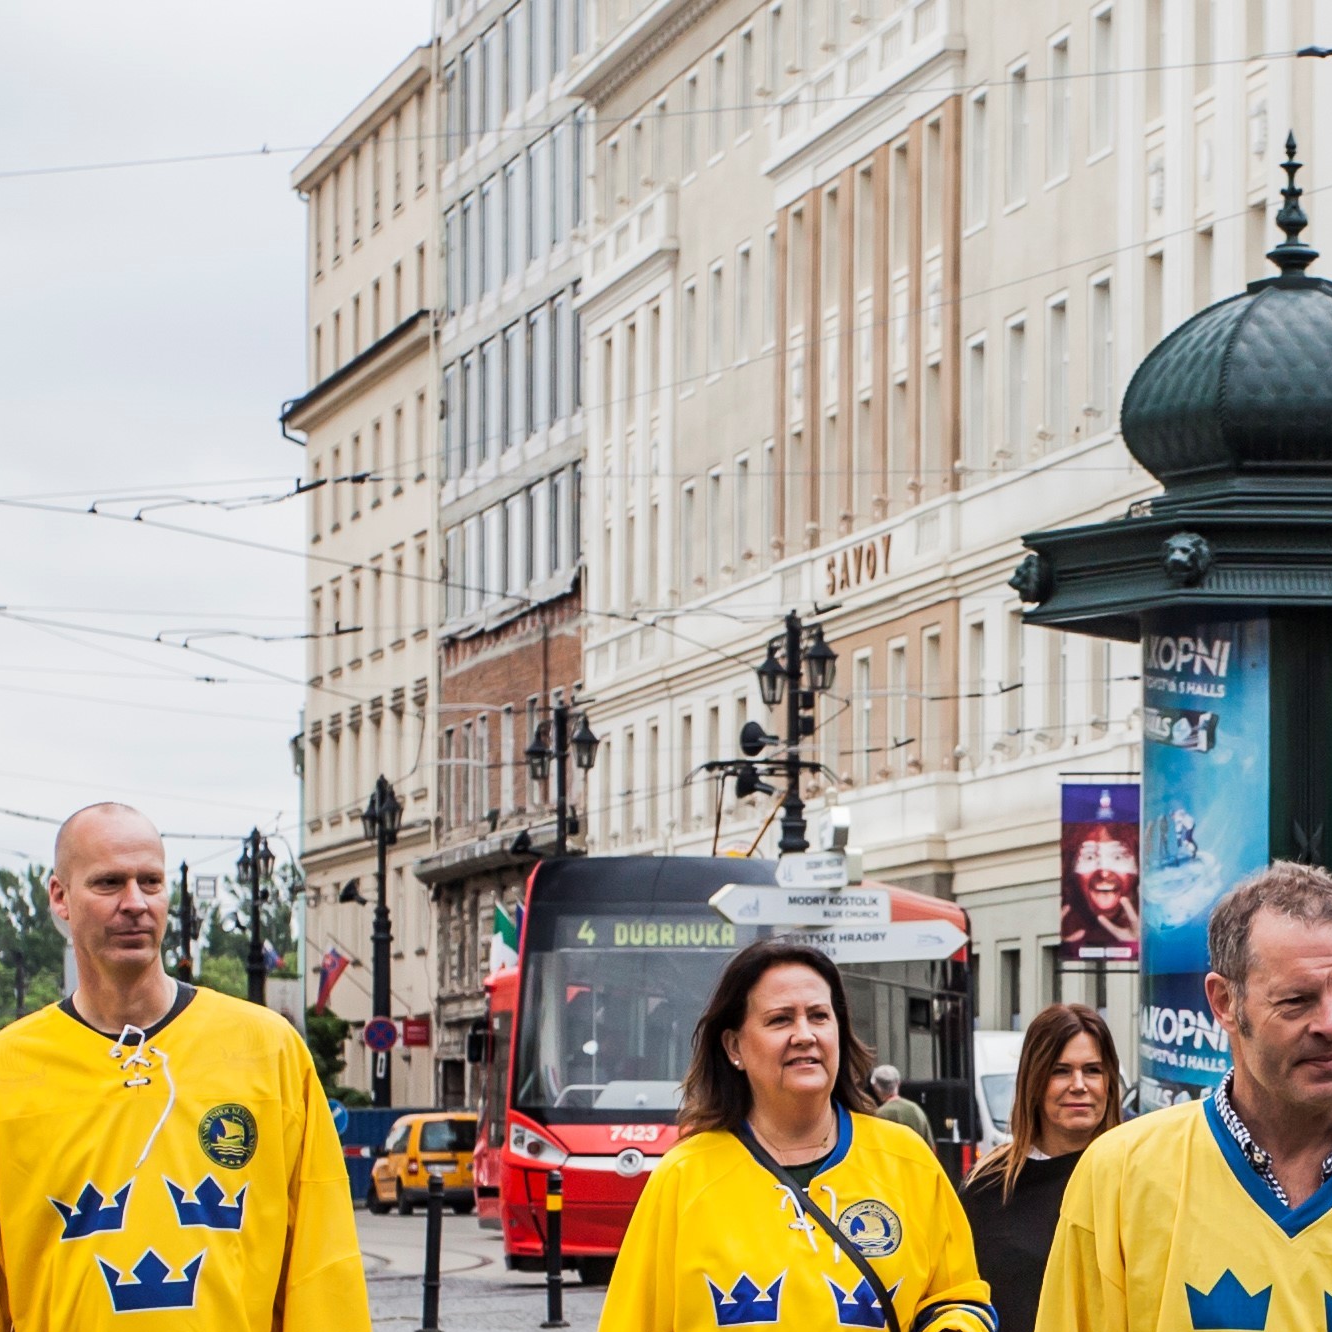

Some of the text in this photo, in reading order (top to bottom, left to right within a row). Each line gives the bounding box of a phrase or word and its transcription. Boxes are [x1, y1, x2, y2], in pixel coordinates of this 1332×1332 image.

[827, 533, 891, 596] SAVOY
[1186, 681, 1225, 698] HALLS
[788, 894, 878, 906] MODRÝ KOSTOLÍK
[823, 909, 879, 918] BLUE CHURCH
[577, 918, 736, 946] 4 DÚBRAVKA
[839, 932, 887, 943] HRADBY
[1187, 1055, 1227, 1074] HALLS
[610, 1124, 659, 1142] 7423
